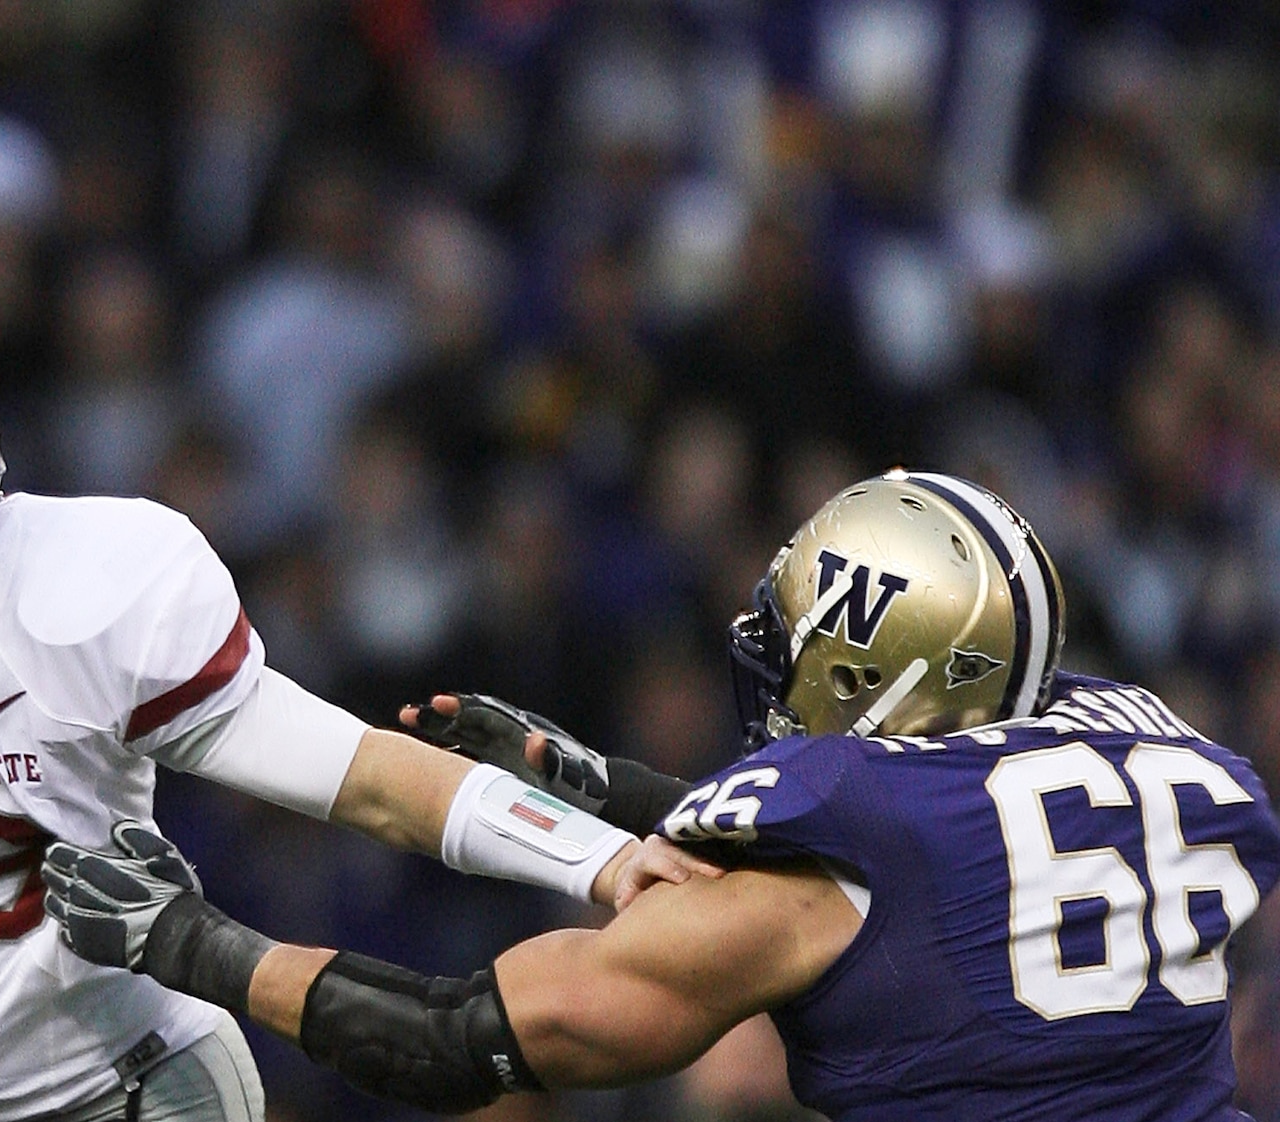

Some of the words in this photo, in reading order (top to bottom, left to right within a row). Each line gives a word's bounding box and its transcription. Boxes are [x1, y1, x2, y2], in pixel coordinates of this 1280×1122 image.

[816, 548, 910, 650] W
[664, 766, 780, 842] 66
[985, 741, 1261, 1021] 66
